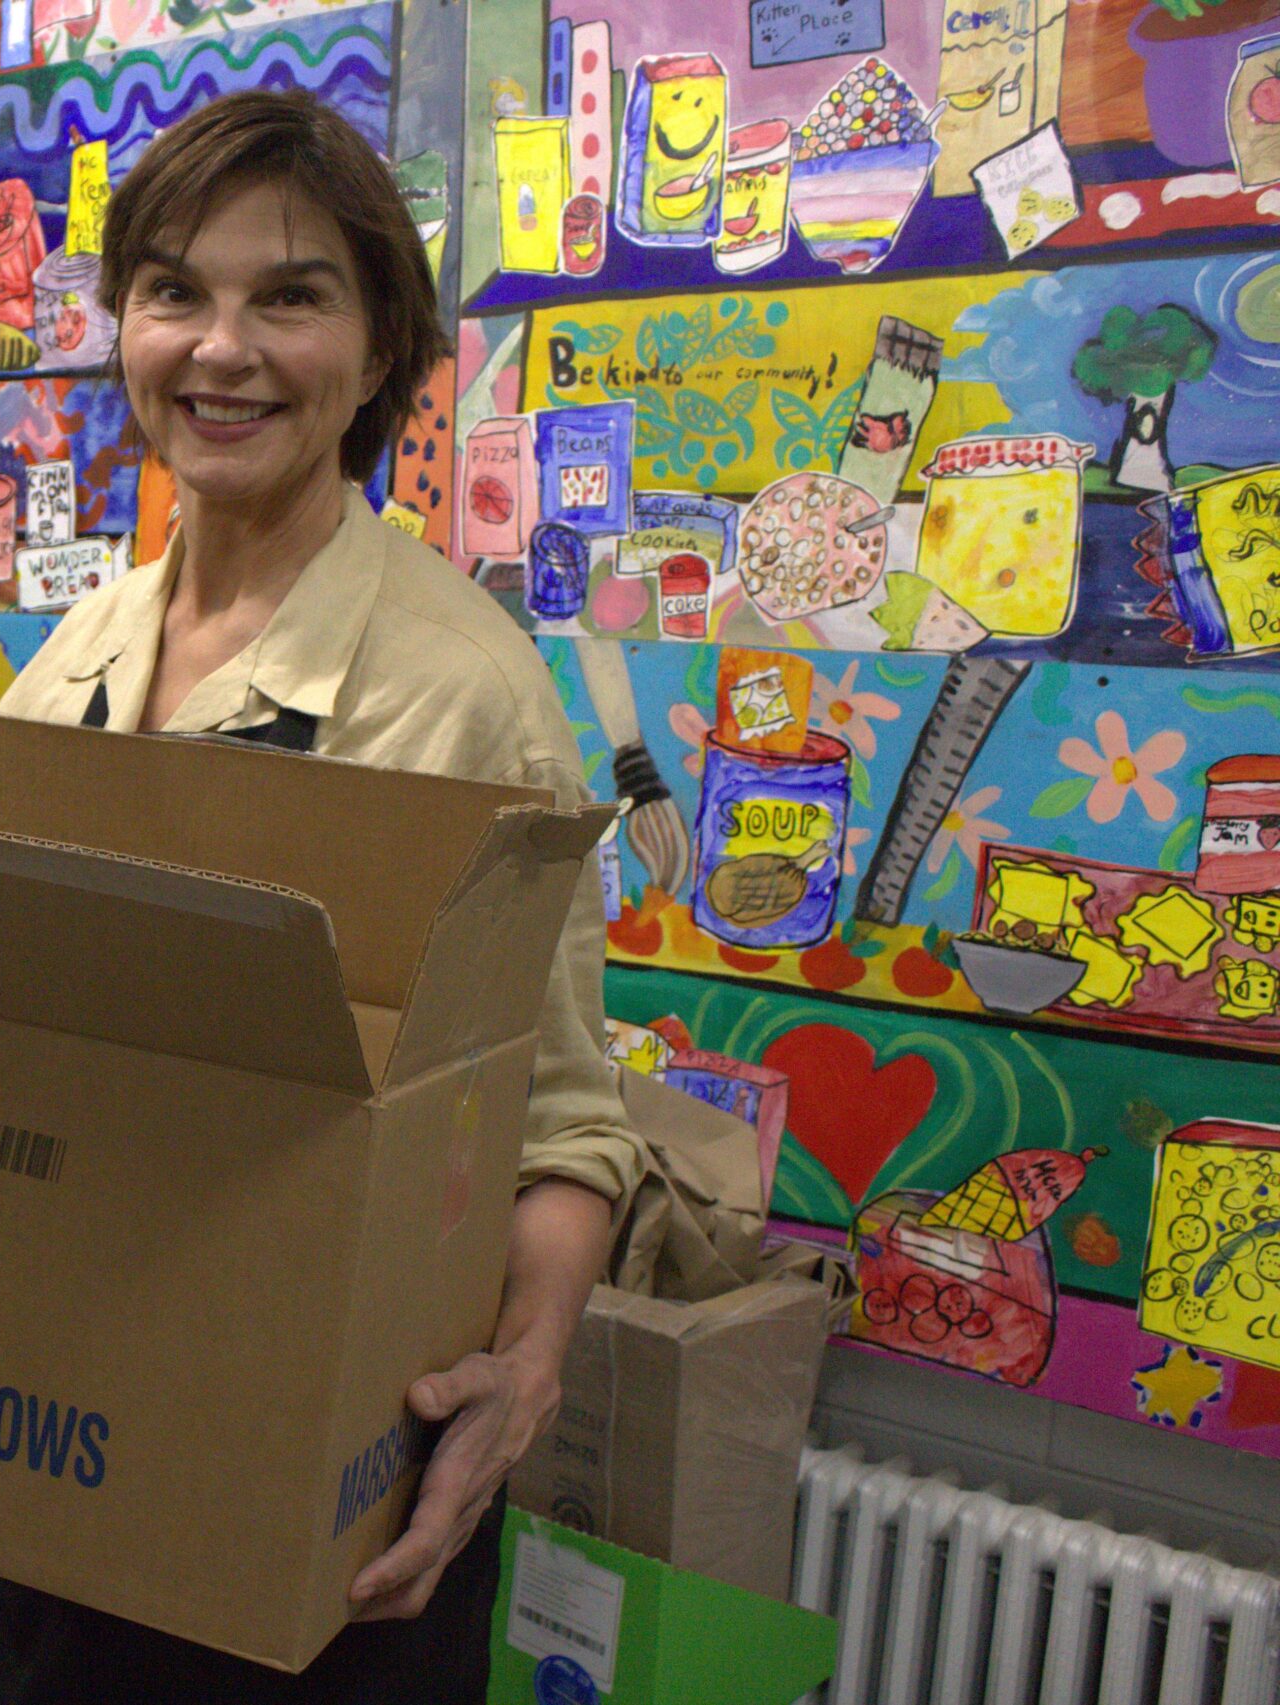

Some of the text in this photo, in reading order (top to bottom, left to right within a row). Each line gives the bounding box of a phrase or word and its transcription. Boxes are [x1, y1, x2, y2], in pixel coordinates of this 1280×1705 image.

[755, 3, 802, 25] Kitten
[548, 336, 593, 387] Be
[604, 354, 659, 385] kind
[661, 361, 683, 385] to
[695, 369, 724, 380] our
[556, 429, 612, 454] Beans
[28, 547, 104, 577] WONDER
[664, 593, 707, 614] coke
[719, 799, 820, 841] SOUP
